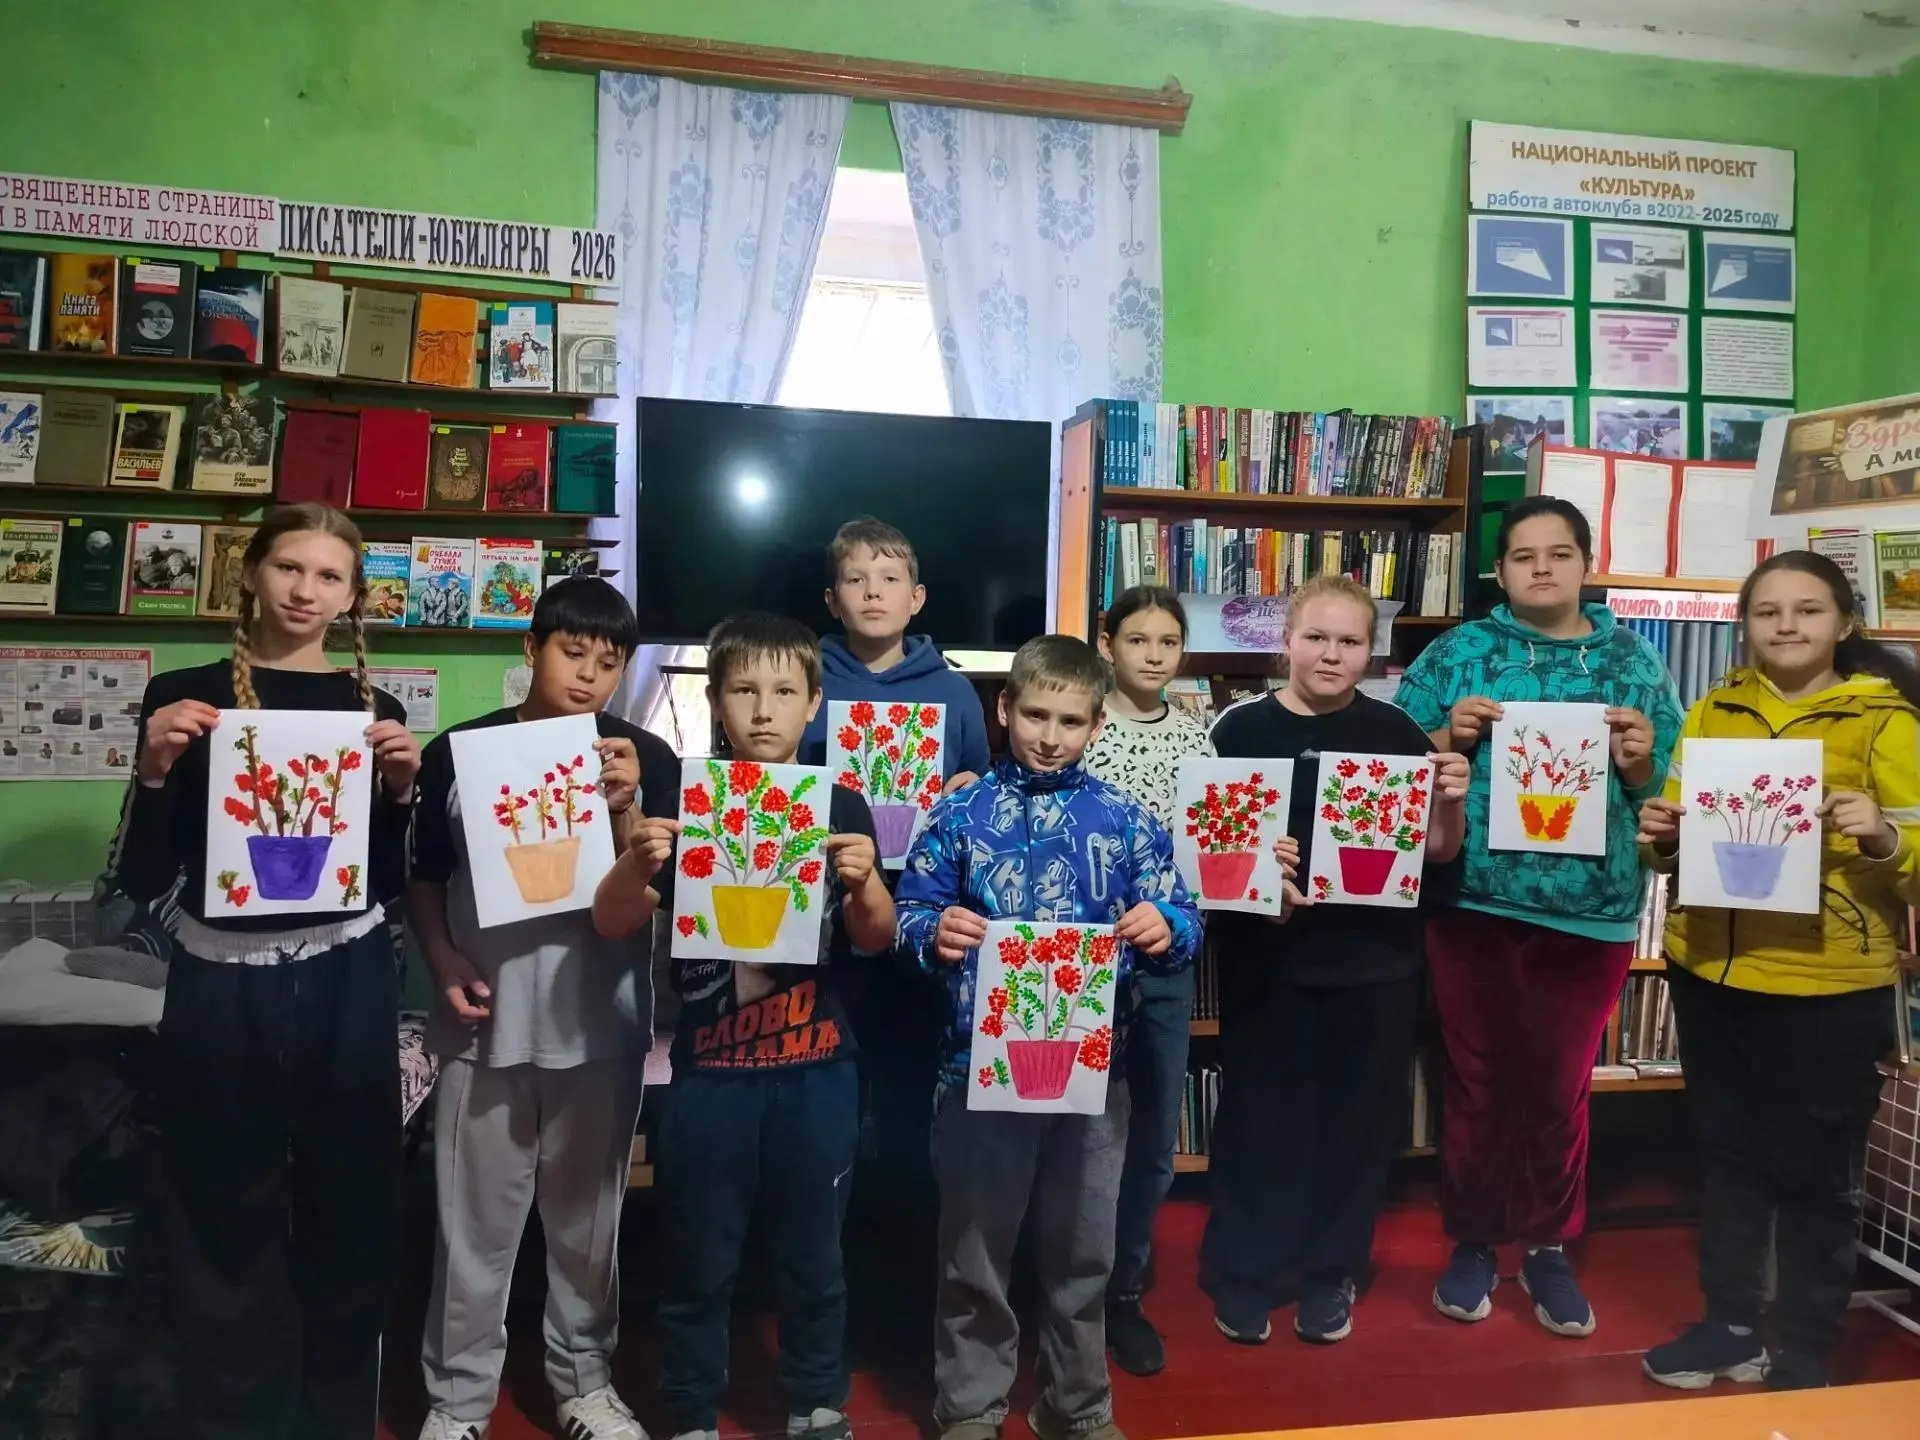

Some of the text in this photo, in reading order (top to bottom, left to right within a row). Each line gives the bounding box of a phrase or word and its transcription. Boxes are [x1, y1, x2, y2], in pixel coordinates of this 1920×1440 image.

[1511, 141, 1757, 179] НАЦИОНАЛЬНЫЙ ПРОЕКТ
[0, 176, 275, 223] СВЯЩЕННЫЕ СТРАНИЦЫ
[1580, 177, 1696, 202] «КУЛЬТУРА»
[1486, 190, 1548, 209] работа
[1553, 199, 1641, 217] автоклуба
[14, 207, 27, 228] В
[35, 208, 133, 239] ПАМЯТИ
[145, 220, 259, 249] ЛЮДСКОЙ
[571, 230, 616, 281] 2026
[59, 304, 100, 316] памяти
[63, 291, 97, 305] Книга
[117, 457, 162, 470] ВАСИЛЬЕВ
[1865, 453, 1885, 471] А
[693, 979, 816, 1055] СЛОВО
